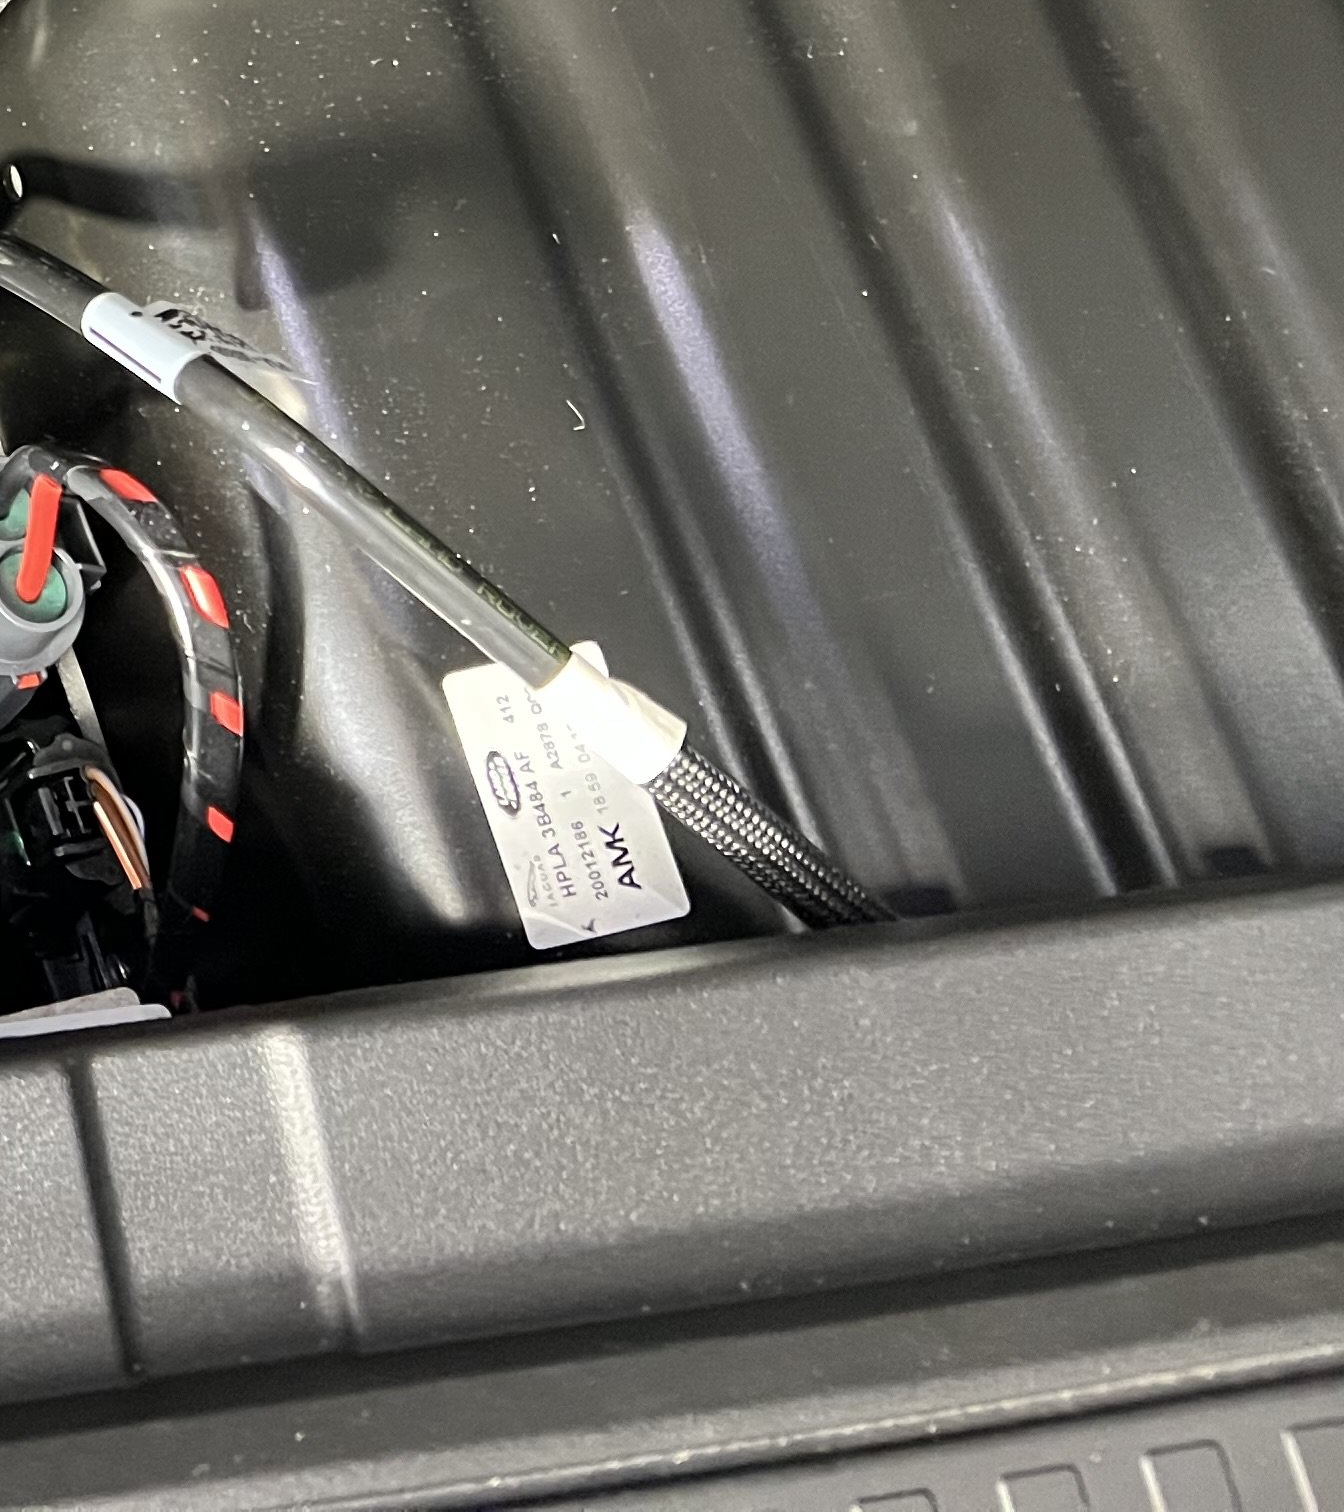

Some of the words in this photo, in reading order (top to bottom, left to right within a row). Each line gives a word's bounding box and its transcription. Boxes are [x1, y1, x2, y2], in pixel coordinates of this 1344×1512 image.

[514, 751, 535, 774] AF
[537, 722, 563, 770] A2878
[525, 780, 556, 839] 3B484
[547, 843, 576, 898] HPLA
[571, 821, 609, 901] 20012186
[598, 822, 642, 890] AMK
